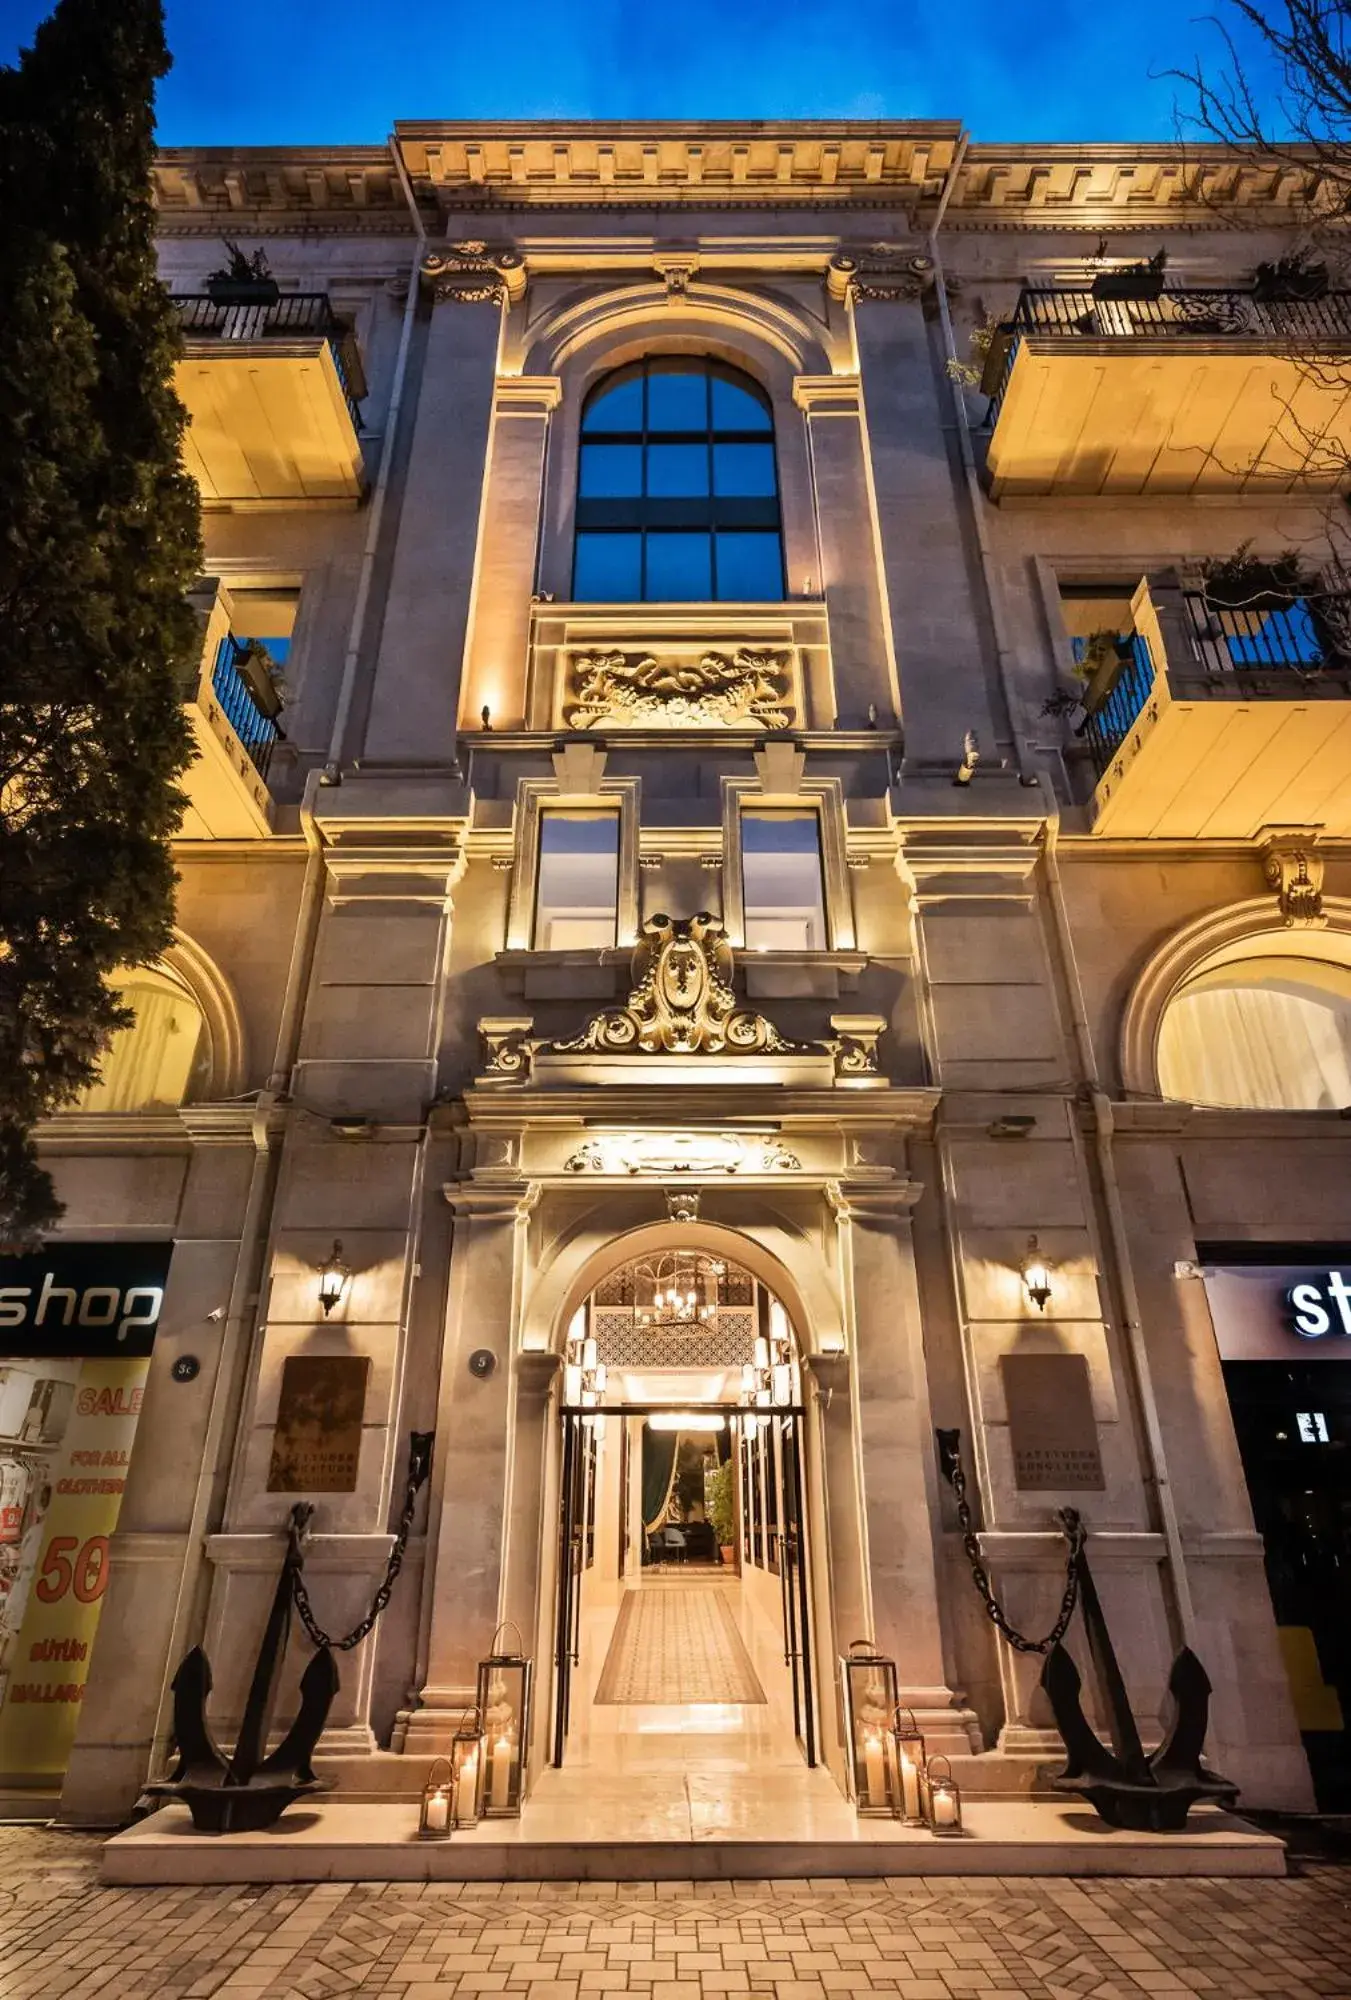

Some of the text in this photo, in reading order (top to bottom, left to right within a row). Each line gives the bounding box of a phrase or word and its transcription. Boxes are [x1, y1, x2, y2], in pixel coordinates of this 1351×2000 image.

[0, 1272, 164, 1342] shop
[77, 1386, 145, 1416] SALE
[70, 1450, 129, 1467] FOR ALL
